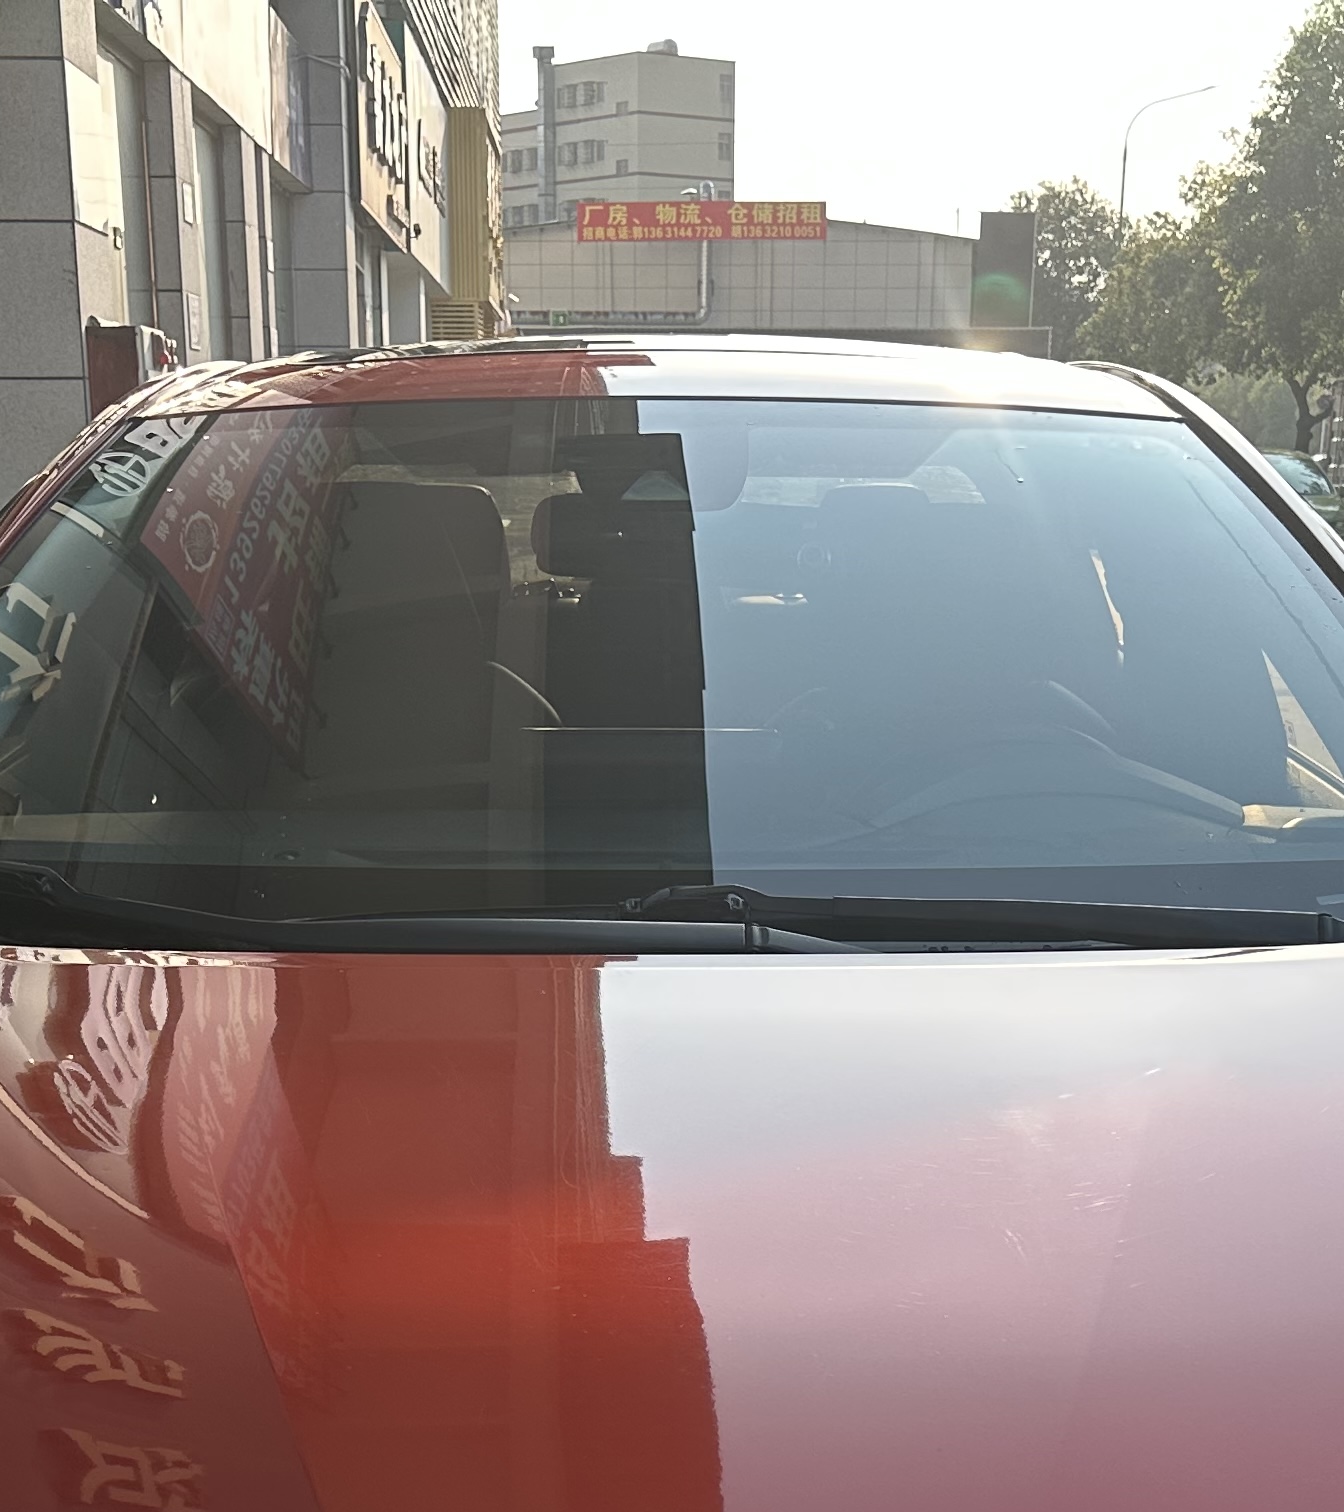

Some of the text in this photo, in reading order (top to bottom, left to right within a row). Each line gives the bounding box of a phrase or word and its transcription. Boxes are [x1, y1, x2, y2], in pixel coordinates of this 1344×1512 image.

[582, 203, 823, 226] 厂房、物流、仓储招租
